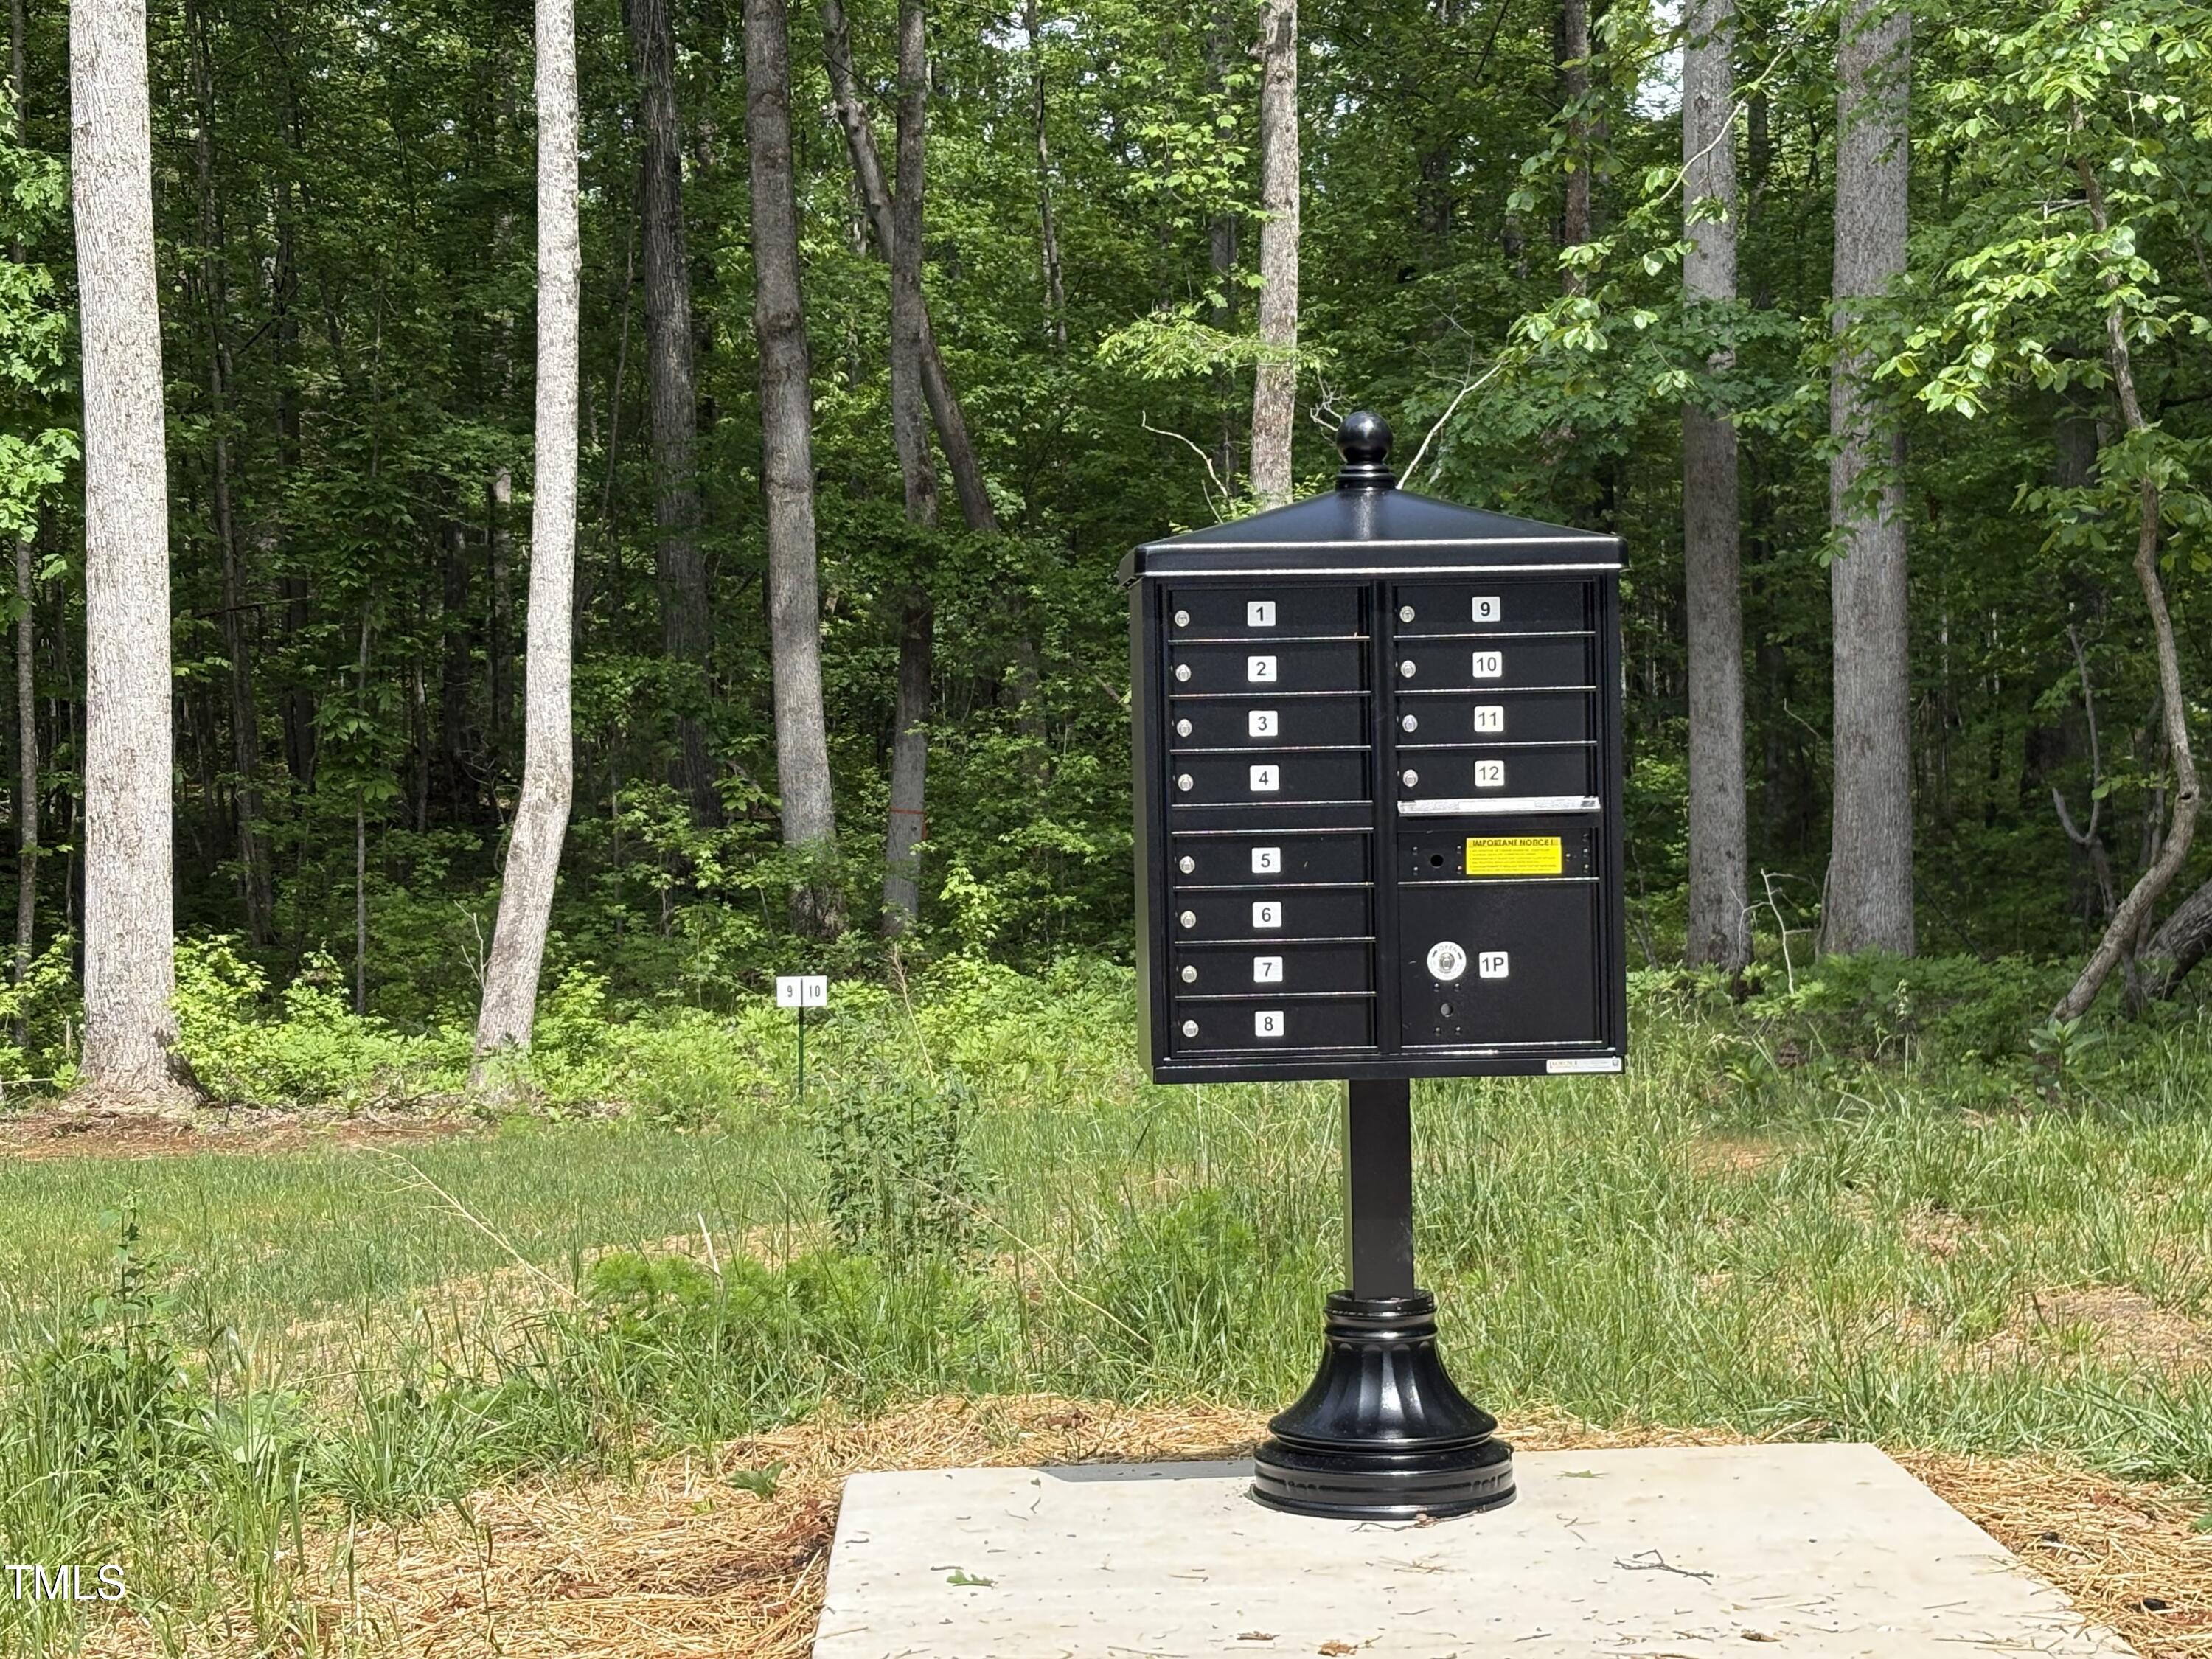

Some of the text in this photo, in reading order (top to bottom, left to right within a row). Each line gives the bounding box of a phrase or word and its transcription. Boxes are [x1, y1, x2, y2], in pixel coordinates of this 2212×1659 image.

[1256, 606, 1264, 622] 1
[1480, 601, 1491, 617] 9
[1256, 661, 1266, 676] 2
[1477, 657, 1497, 672] 10
[1258, 716, 1267, 731] 3
[1478, 712, 1497, 726] 11
[1259, 771, 1269, 785] 4
[1479, 766, 1499, 780] 12
[1472, 839, 1517, 847] IMPORTANT
[1261, 853, 1270, 868] 5
[1262, 907, 1271, 922] 6
[1438, 945, 1458, 953] OPEN
[1262, 962, 1273, 977] 7
[1481, 956, 1504, 972] 1P
[787, 985, 793, 998] 9
[809, 985, 821, 998] 10
[1264, 1016, 1273, 1032] 8
